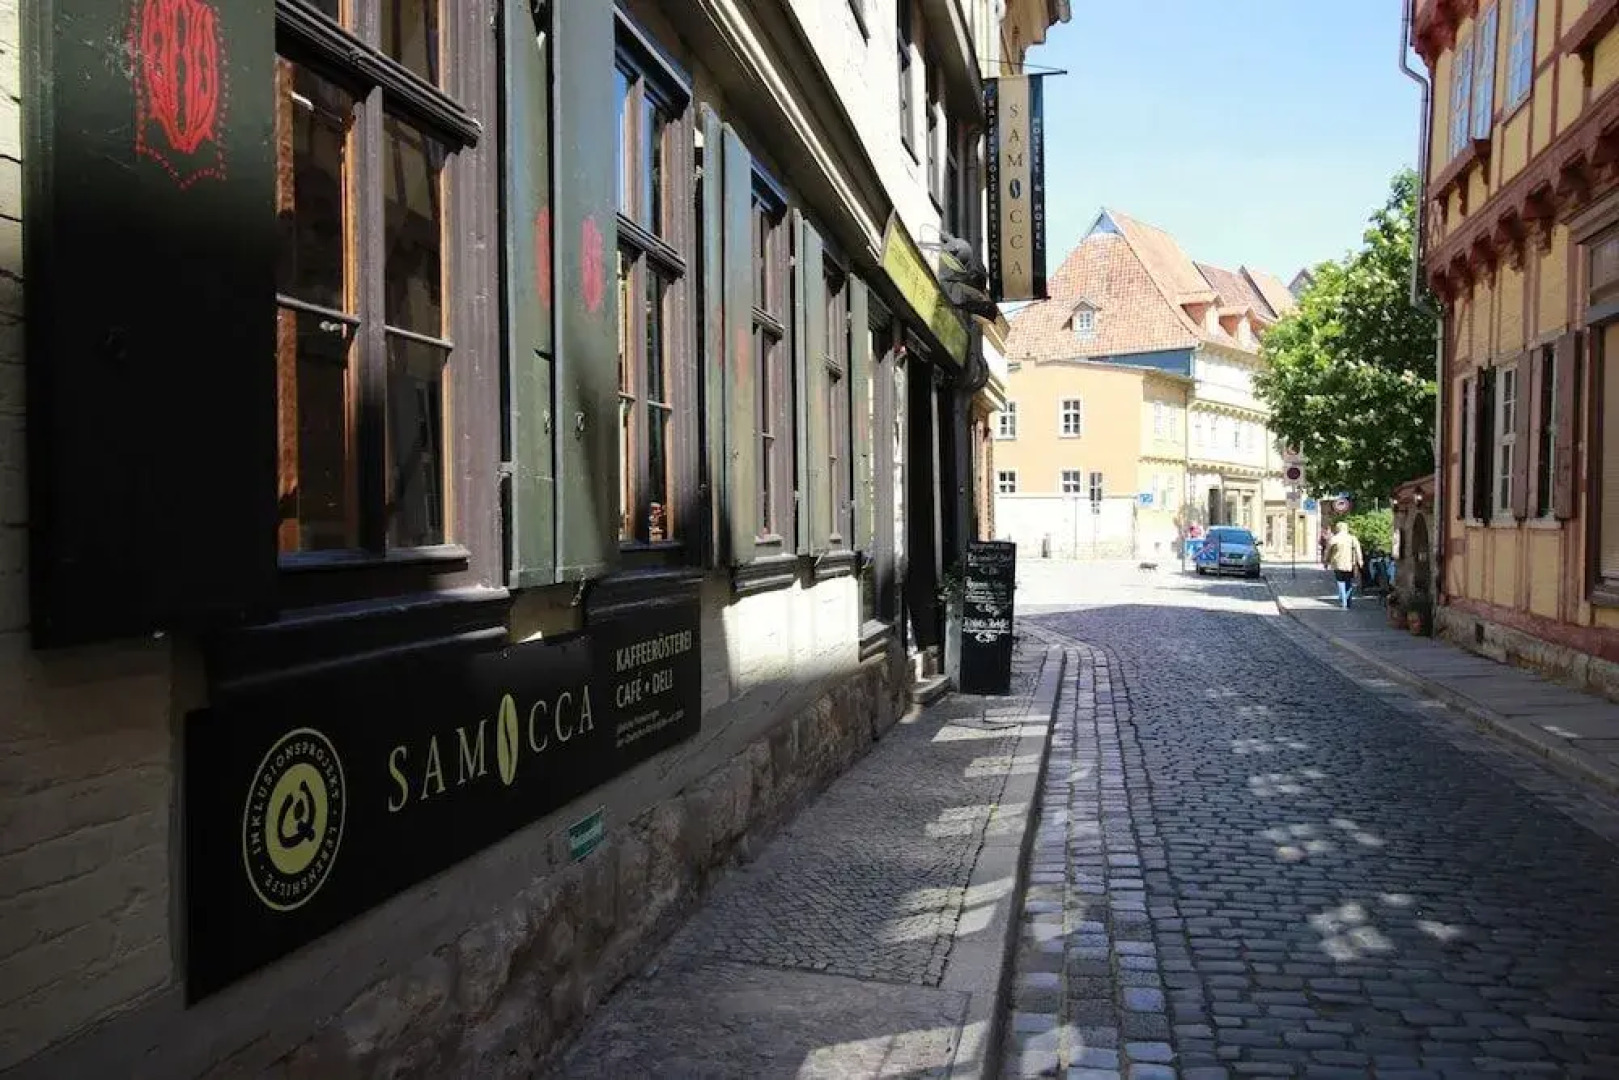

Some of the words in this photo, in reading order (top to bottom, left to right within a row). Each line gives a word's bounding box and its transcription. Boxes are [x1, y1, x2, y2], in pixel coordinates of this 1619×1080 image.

[1034, 204, 1043, 251] HOTEL
[616, 631, 693, 672] KAFFEERÖSTEREI
[616, 673, 642, 709] CAFÉ
[652, 669, 674, 694] DELI
